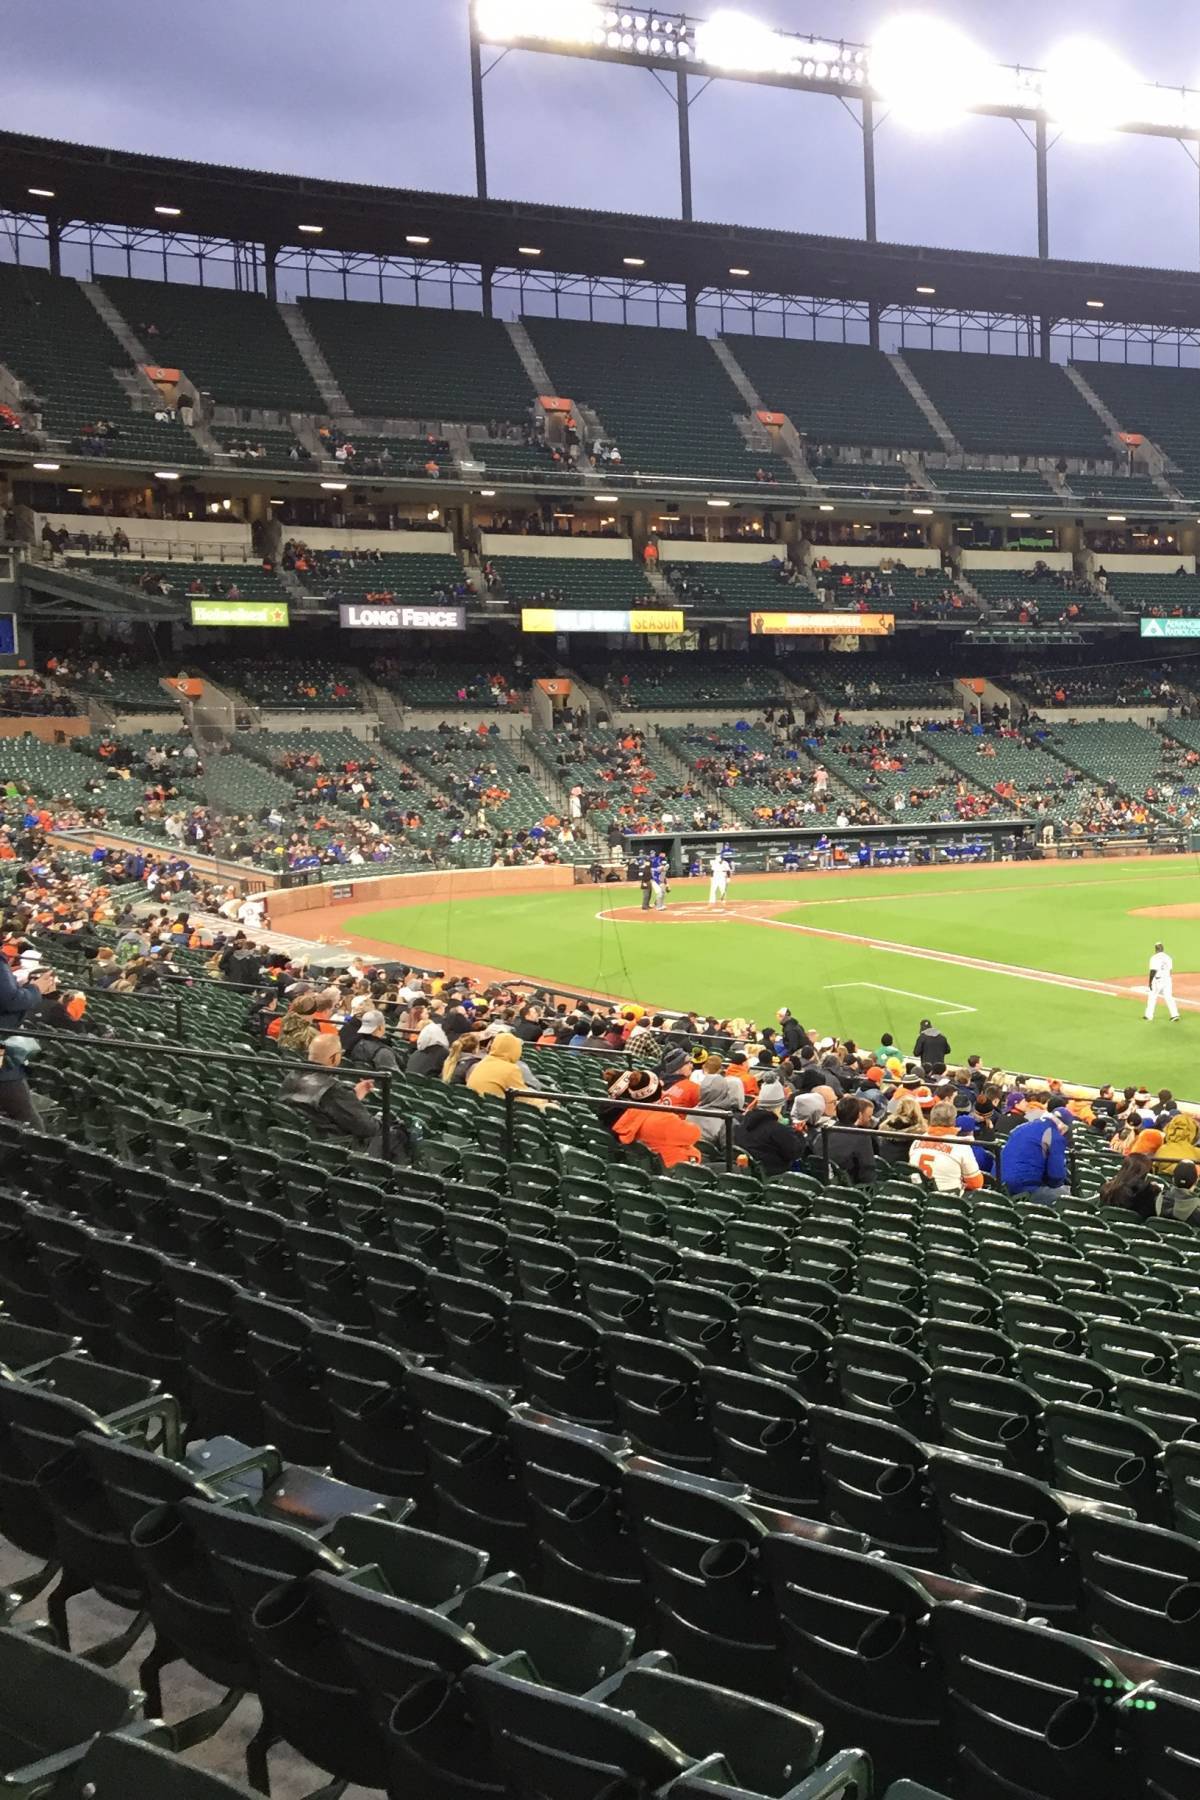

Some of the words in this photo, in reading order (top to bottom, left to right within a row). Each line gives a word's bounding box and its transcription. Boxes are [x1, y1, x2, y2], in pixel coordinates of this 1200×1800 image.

[348, 607, 398, 626] LONG
[403, 609, 457, 627] FENCE
[635, 615, 679, 630] SEASON
[919, 1154, 935, 1179] 5
